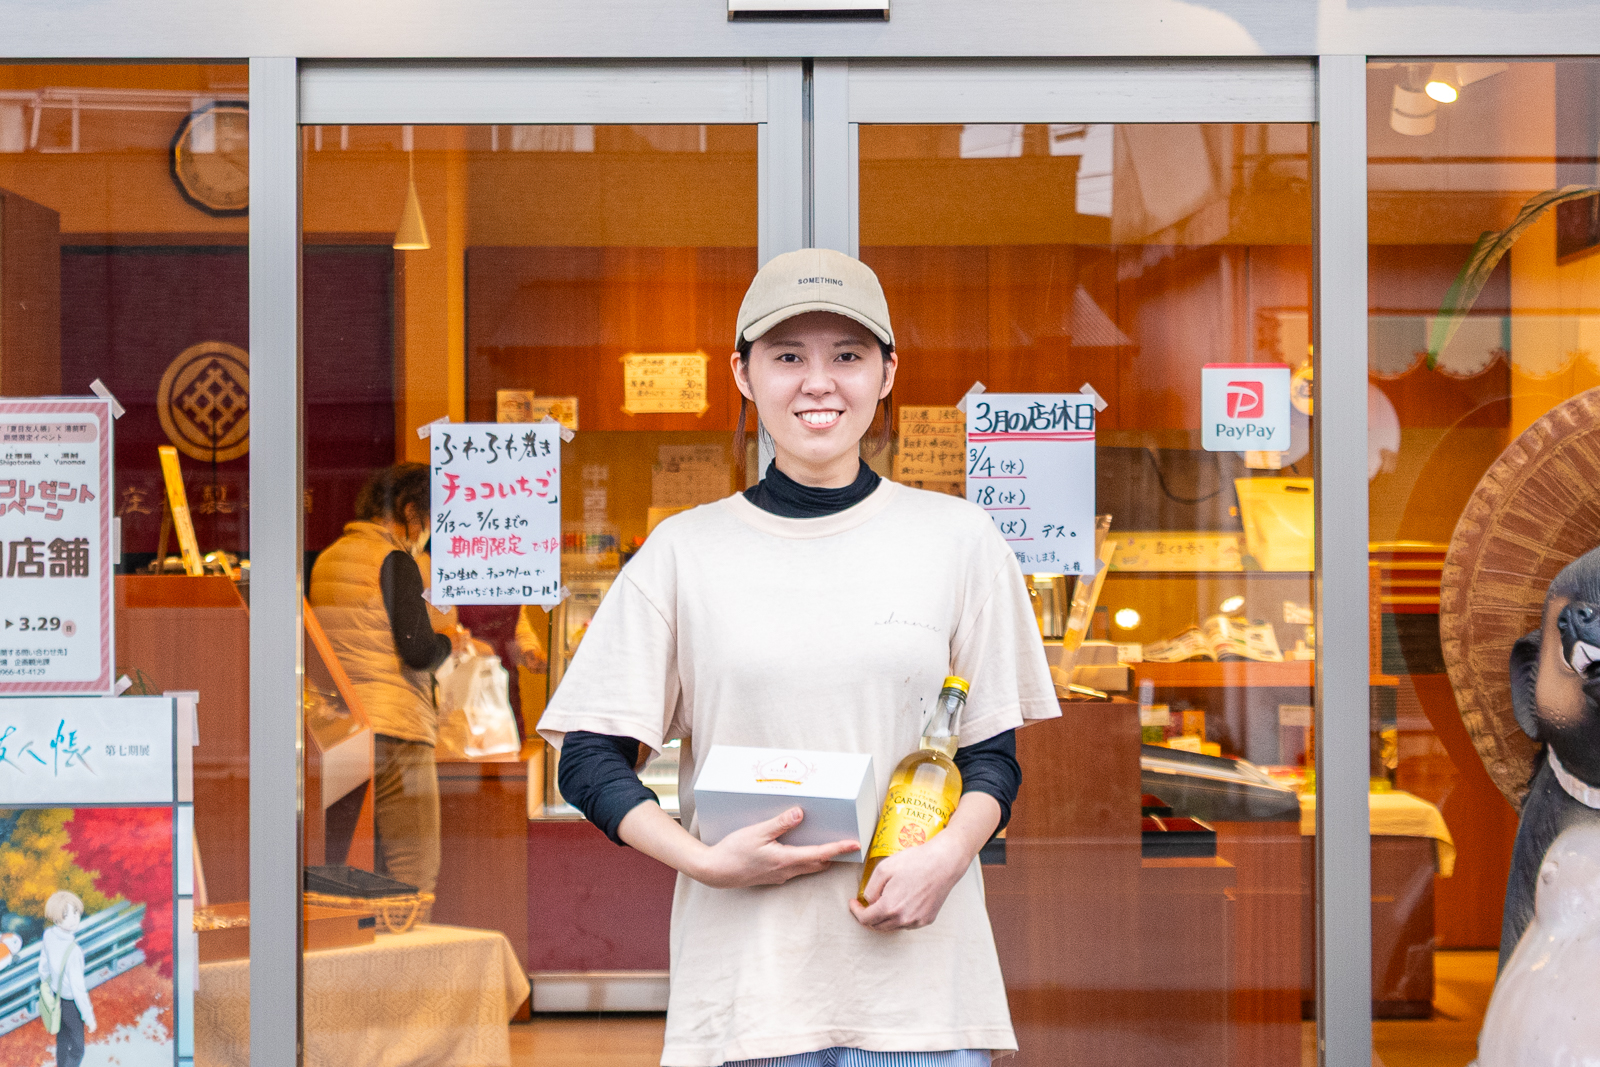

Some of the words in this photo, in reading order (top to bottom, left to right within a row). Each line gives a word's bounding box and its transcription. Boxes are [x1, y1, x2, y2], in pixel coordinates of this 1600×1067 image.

[797, 276, 844, 287] SOMETHING
[974, 399, 1094, 433] 3月の店休日
[1215, 423, 1276, 440] PayPay
[435, 467, 558, 506] 「チョコいちご」
[0, 537, 89, 578] 店舗
[19, 616, 61, 632] 3.29
[105, 744, 150, 757] 第七期展
[894, 795, 948, 819] CARDAMON
